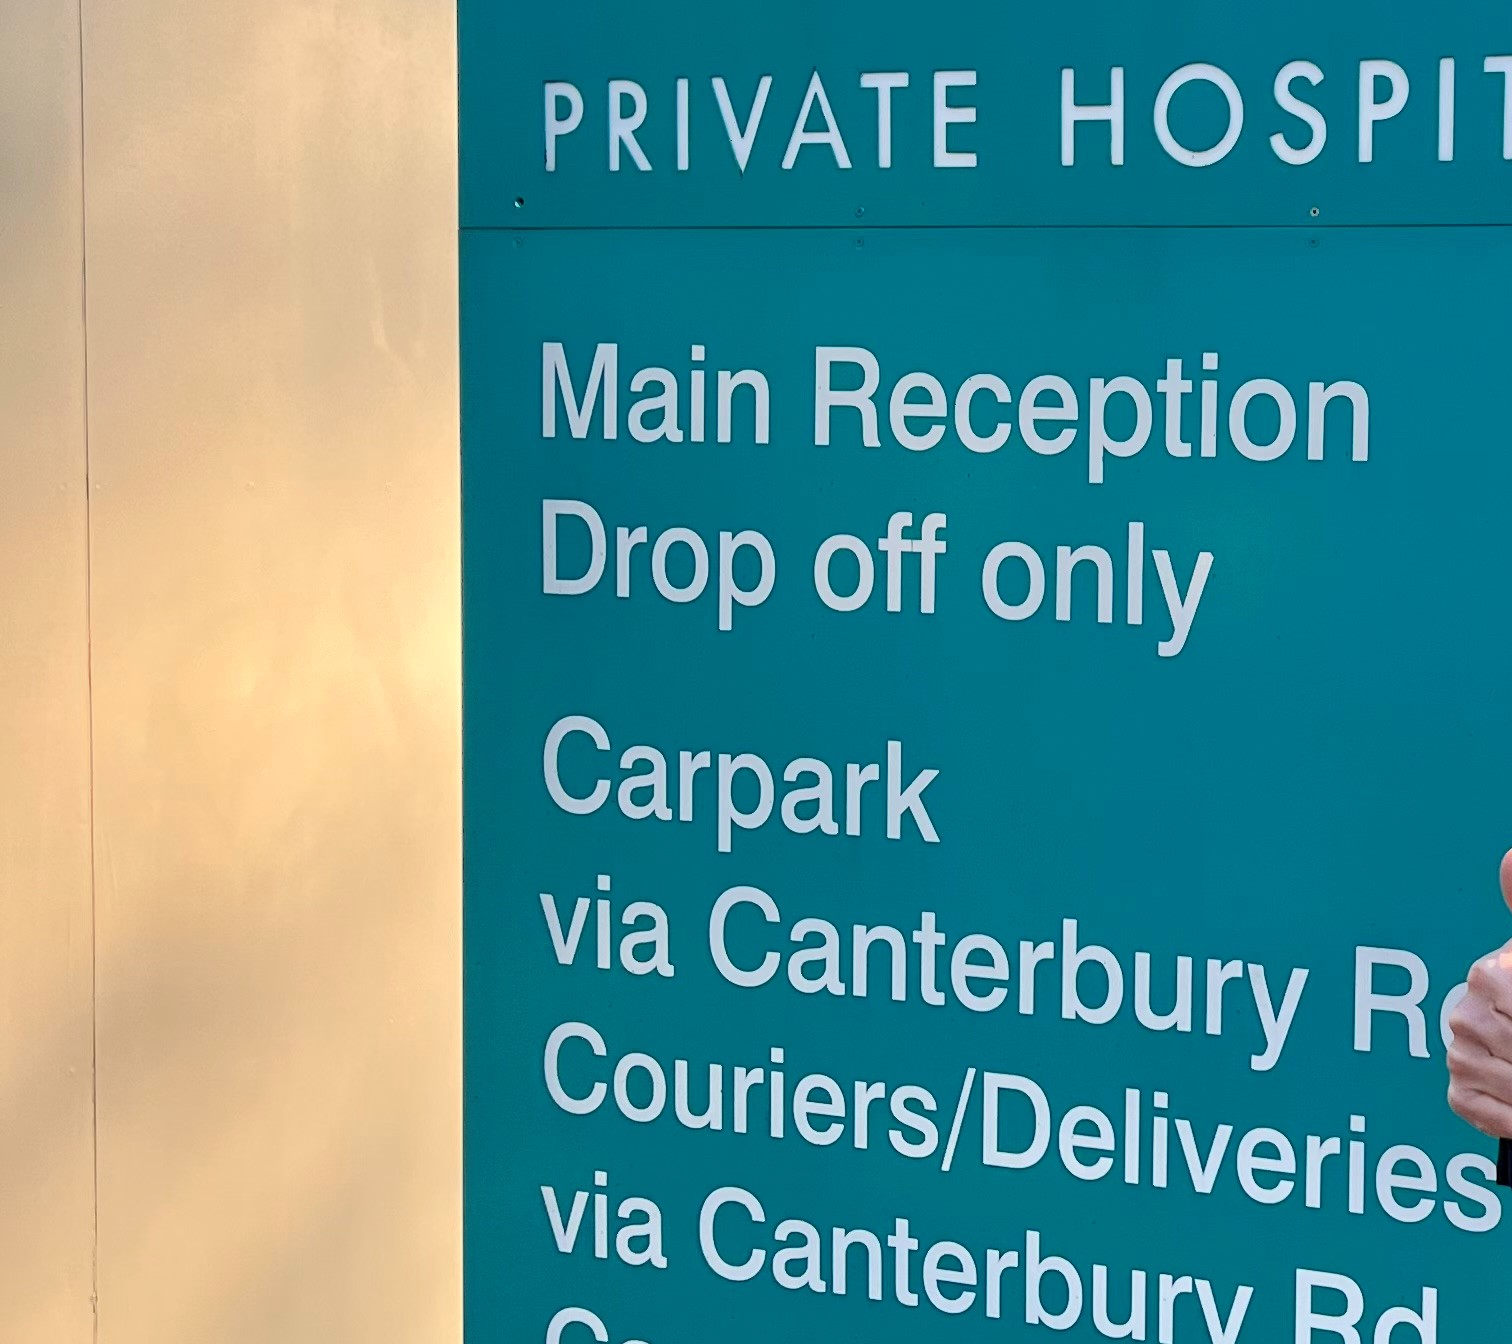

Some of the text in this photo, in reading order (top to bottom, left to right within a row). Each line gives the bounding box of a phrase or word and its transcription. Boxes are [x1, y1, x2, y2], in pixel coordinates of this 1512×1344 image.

[546, 72, 976, 171] PRIVATE
[543, 343, 1368, 483] Main Reception
[544, 500, 1213, 656] Drop off only
[544, 716, 939, 852] Carpark
[541, 875, 1470, 1070] via Canterbury R
[545, 1023, 1501, 1231] Couriers/Deliveries
[541, 1171, 667, 1268] via
